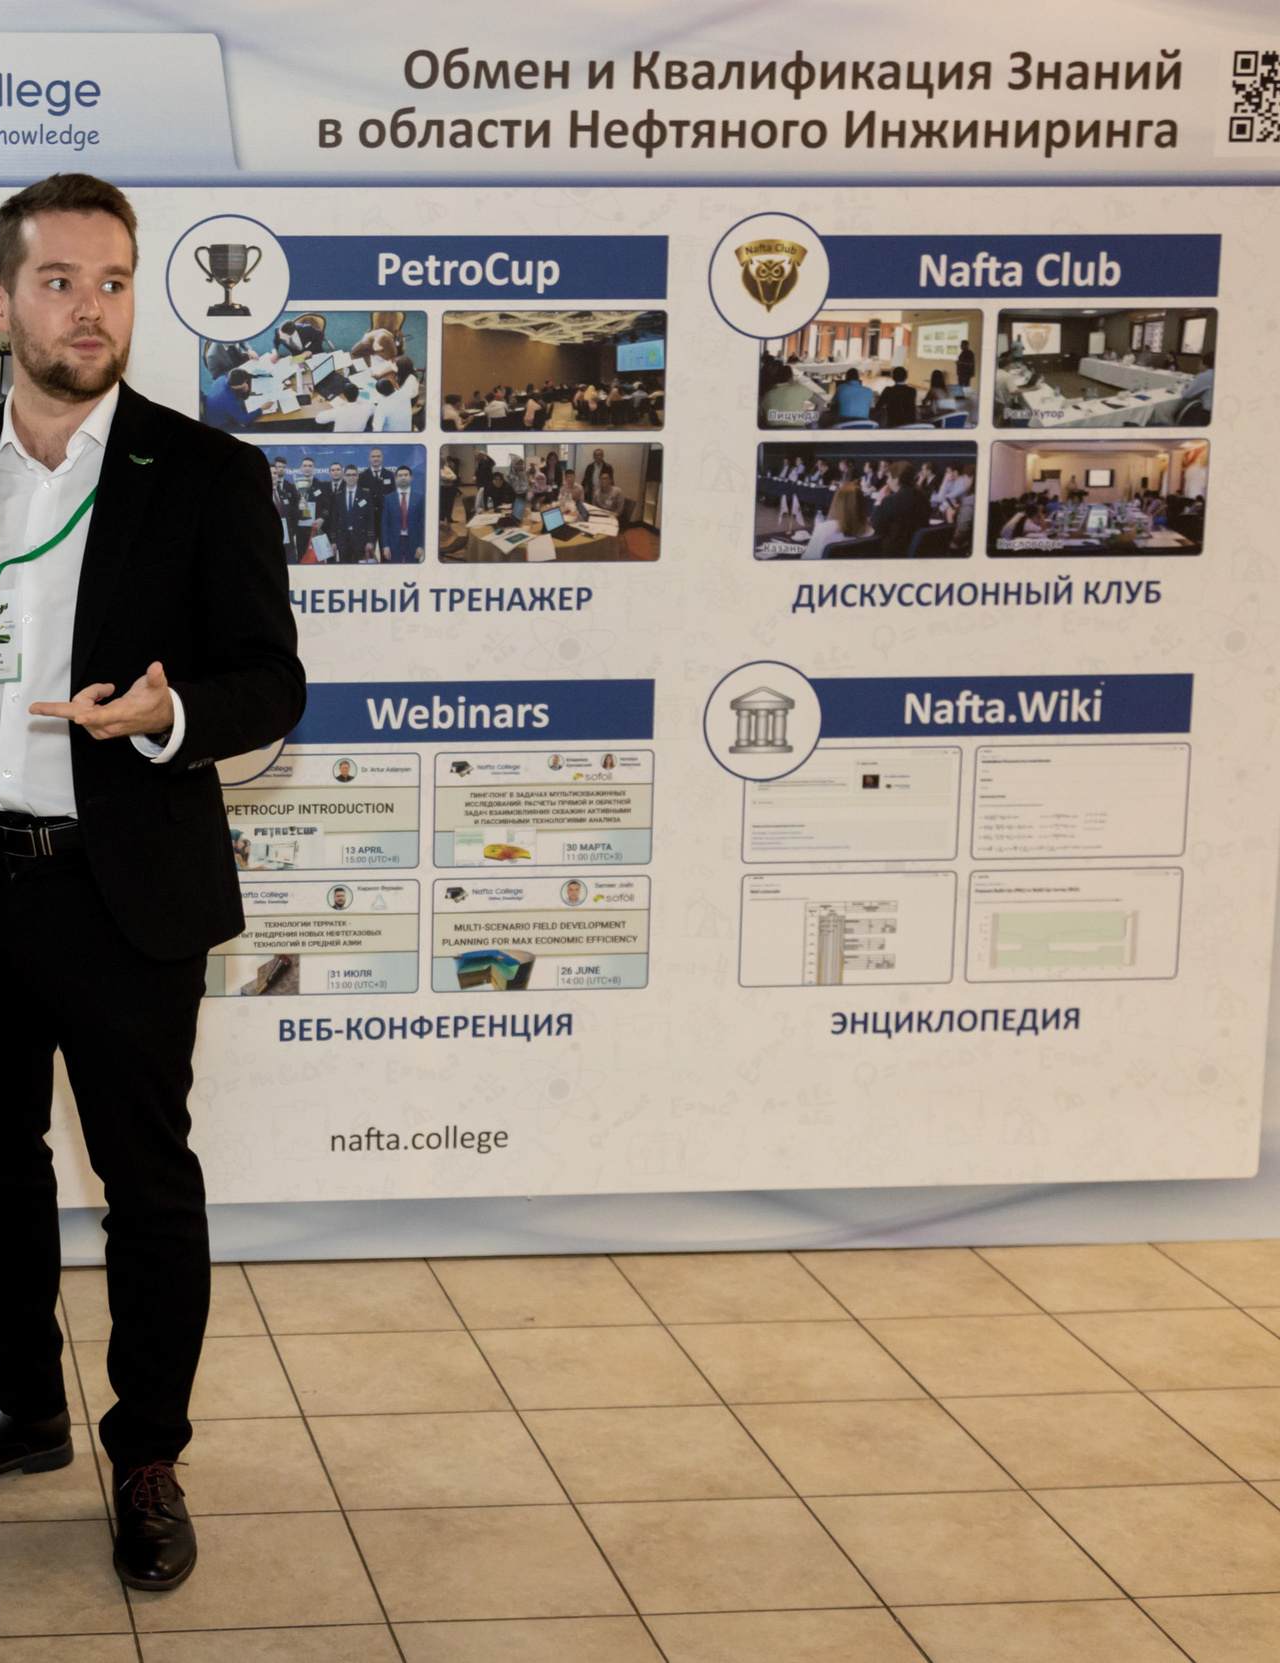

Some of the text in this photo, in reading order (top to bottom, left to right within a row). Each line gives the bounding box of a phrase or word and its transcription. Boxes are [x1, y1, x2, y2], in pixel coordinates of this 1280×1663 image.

[404, 47, 1183, 100] Обмен и Квалификация Знаний
[318, 106, 1179, 158] в области Нефтяного Инжиниринга
[745, 242, 797, 255] Nafta Club
[377, 251, 560, 294] PetroCup
[919, 250, 1122, 288] Nafta Club
[289, 581, 593, 614] ЧЕБНЫЙ ТРЕНАЖЕР
[791, 575, 1162, 614] ДИСКУССИОННЫЙ КЛУБ
[367, 696, 550, 731] Webinars
[903, 687, 1104, 726] Nafta.Wiki
[226, 802, 395, 816] PETROCUP INTRODUCTION
[345, 846, 384, 854] 13 APRIL
[579, 843, 612, 851] МАРТА
[345, 856, 367, 864] 15:00
[235, 931, 253, 939] ПЫТ
[454, 920, 627, 932] MULTI-SCENARIO FIELD DEVELOPMENT
[442, 937, 490, 947] PLANNING
[492, 937, 510, 946] FOR
[535, 935, 584, 945] ECONOMIC
[330, 969, 373, 978] 31 ИЮЛЯ
[561, 966, 601, 975] 26 JUNE
[330, 981, 352, 989] 13:00
[278, 1012, 574, 1043] ВЕБ-КОНФЕРЕНЦИЯ
[830, 1007, 1081, 1039] ЭНЦИКЛОПЕДИЯ
[330, 1124, 509, 1155] nafta.college
